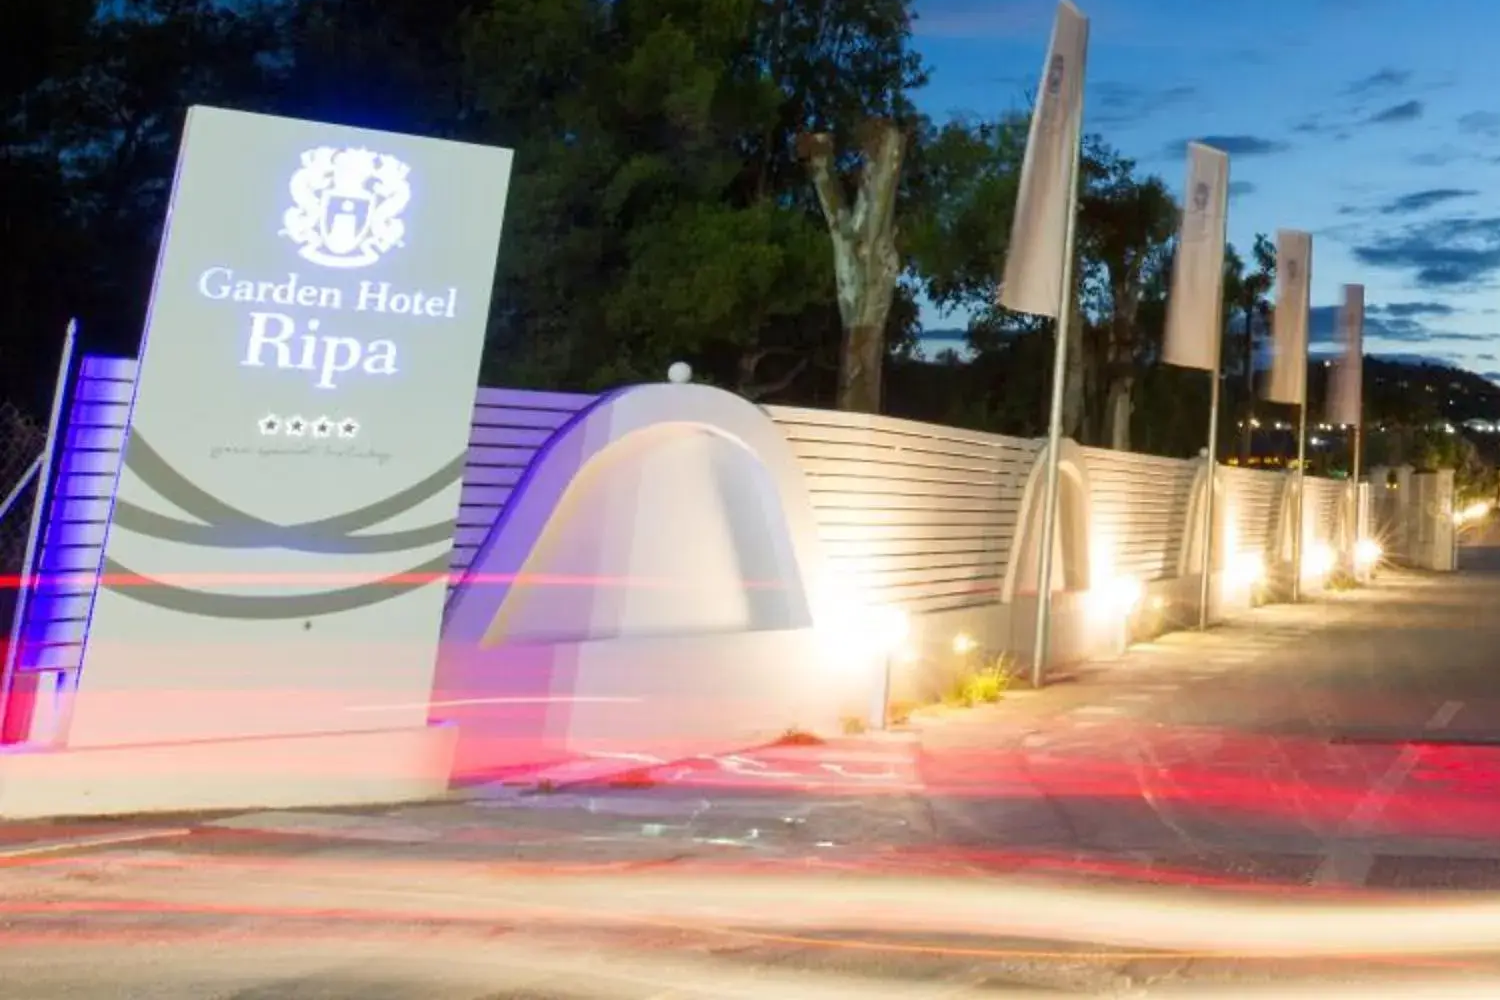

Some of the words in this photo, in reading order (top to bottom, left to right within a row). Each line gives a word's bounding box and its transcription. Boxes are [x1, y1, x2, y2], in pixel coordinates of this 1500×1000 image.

[198, 266, 342, 309] Garden
[354, 280, 458, 318] Hotel
[240, 311, 399, 389] Ripa
